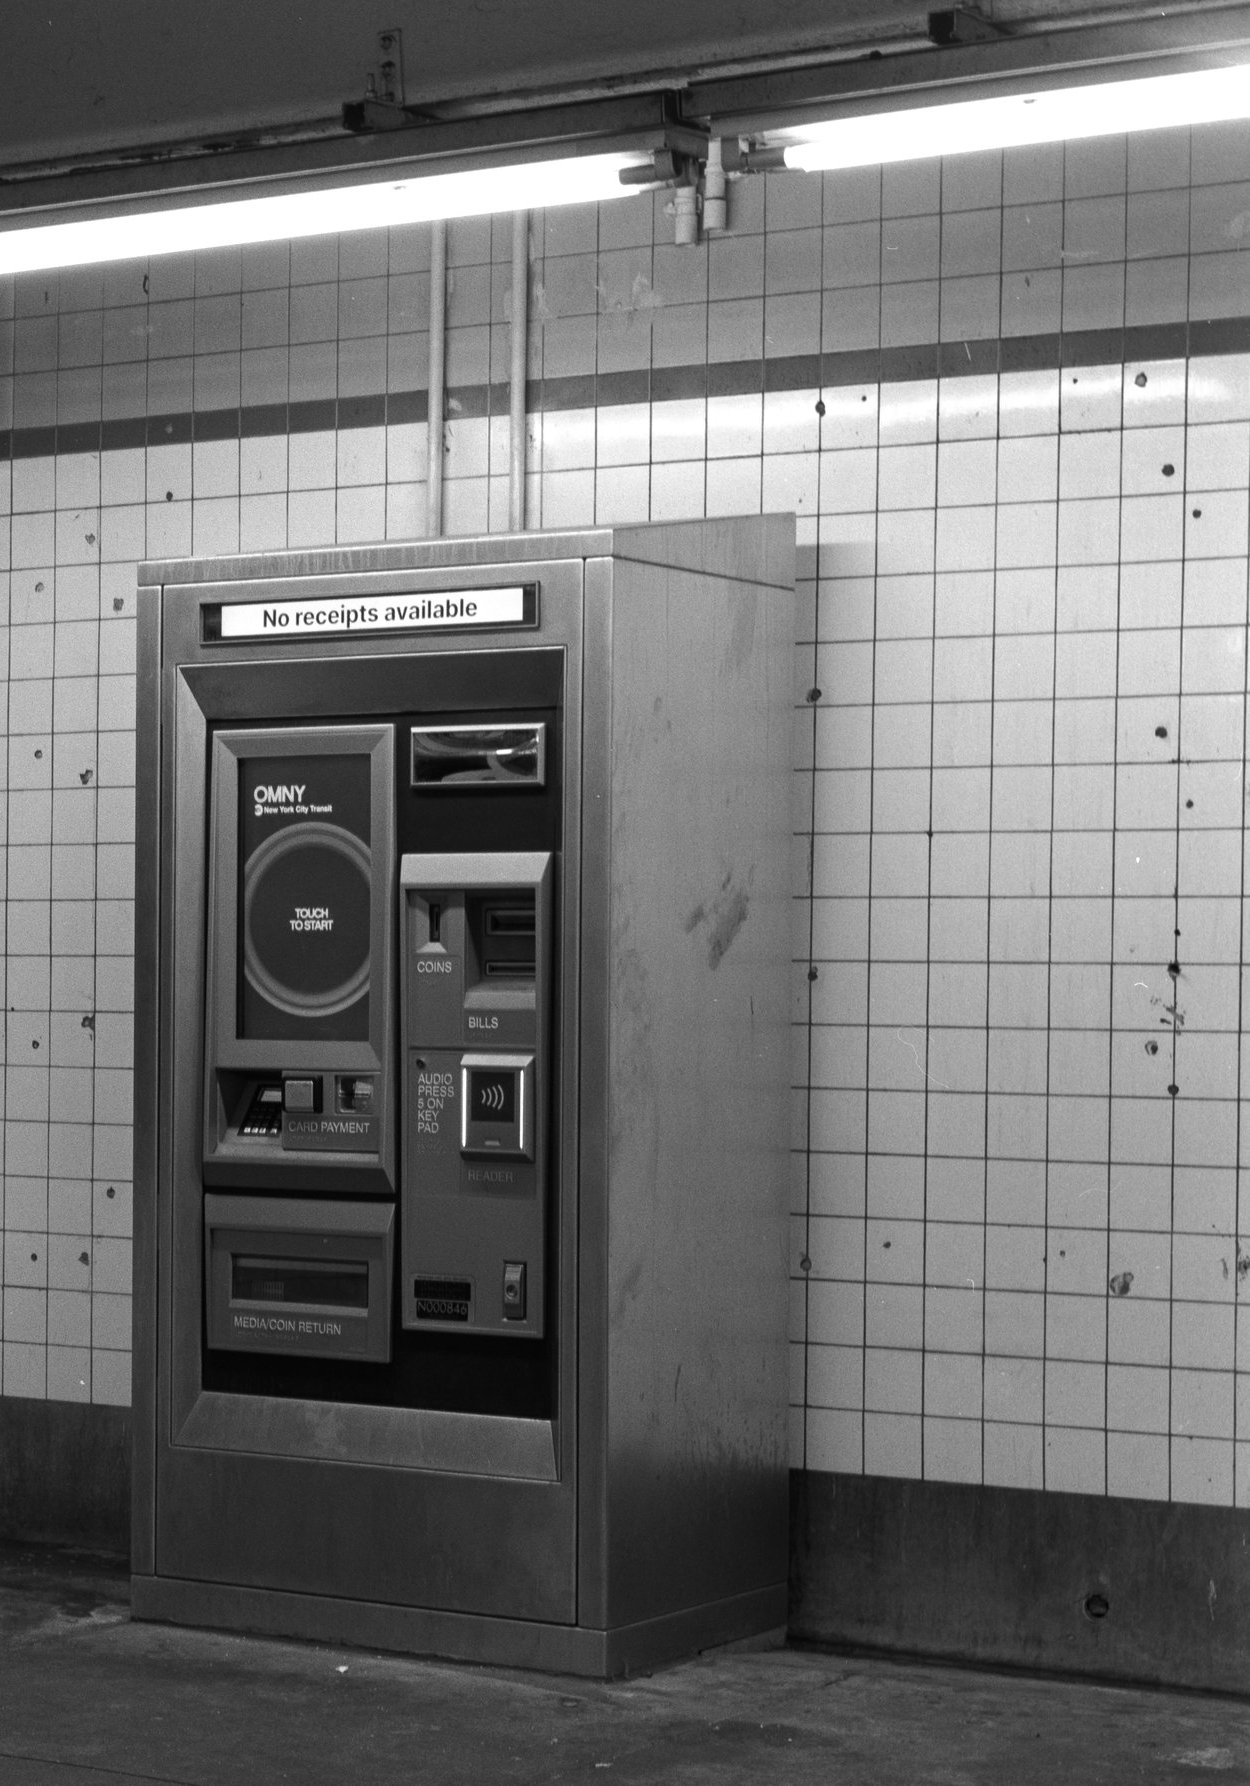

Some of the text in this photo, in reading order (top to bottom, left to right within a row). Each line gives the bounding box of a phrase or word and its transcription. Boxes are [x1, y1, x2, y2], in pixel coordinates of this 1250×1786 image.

[262, 598, 478, 629] No receipts available
[253, 785, 306, 803] OMNY
[263, 806, 279, 814] New
[279, 805, 294, 814] York
[295, 804, 309, 815] City
[309, 804, 333, 813] Transit
[295, 907, 329, 919] TOUCH
[290, 920, 334, 931] TO START
[417, 961, 452, 973] COINS
[468, 1016, 499, 1029] BILLS
[418, 1073, 453, 1085] AUDIO
[418, 1085, 455, 1097] PRESS
[417, 1098, 444, 1109] 5 ON
[417, 1110, 439, 1121] KEY
[288, 1120, 370, 1134] CARD PAYMENT
[417, 1122, 439, 1134] PAD
[468, 1170, 514, 1183] READER
[417, 1301, 467, 1316] N000846
[234, 1315, 342, 1336] MEDIA/COIN RETURN
